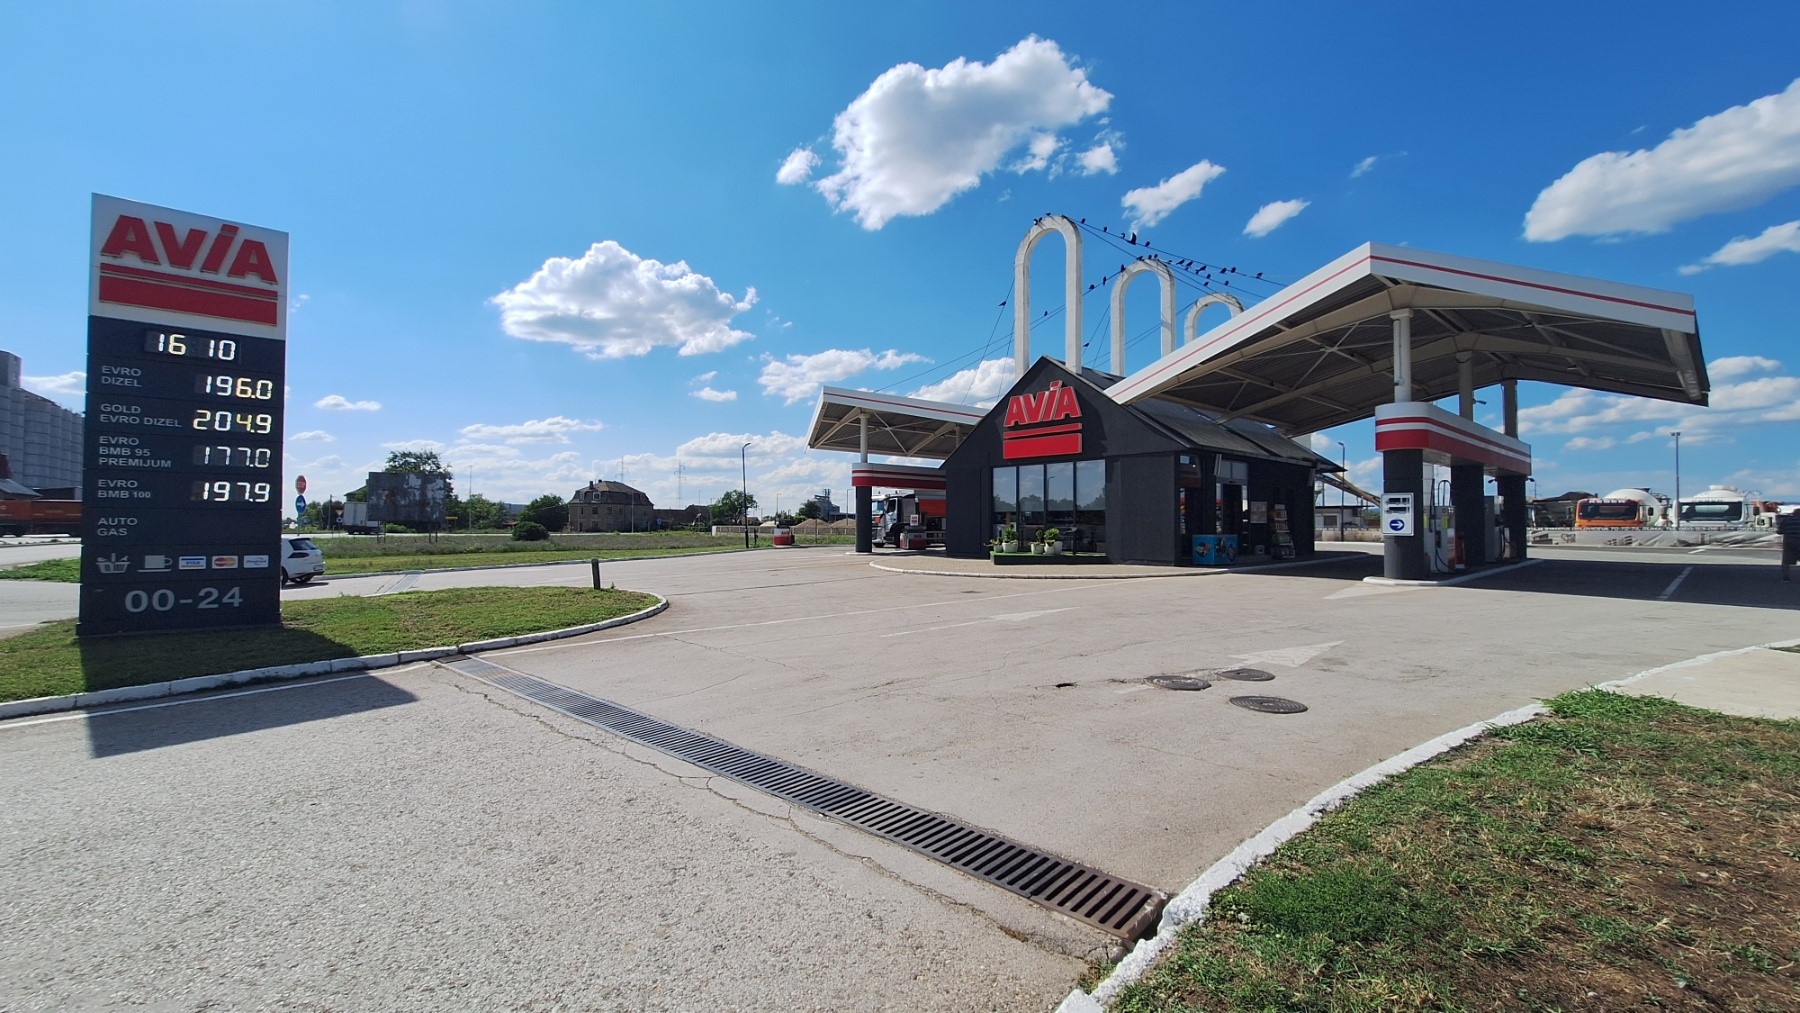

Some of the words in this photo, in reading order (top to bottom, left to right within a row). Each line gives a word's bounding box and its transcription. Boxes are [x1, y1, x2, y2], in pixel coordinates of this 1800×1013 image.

[157, 333, 186, 356] 16
[208, 339, 236, 361] 10
[101, 365, 142, 377] EVRO
[101, 376, 142, 388] DIZEL
[205, 375, 273, 400] 196.0
[100, 403, 141, 414] GOLD
[100, 414, 141, 425] EVRO
[144, 416, 182, 427] DIZEL
[192, 409, 272, 434] 204.9
[99, 435, 140, 446] EVRO
[99, 446, 131, 456] BMB
[135, 448, 150, 457] 95
[203, 446, 271, 468] 177.0
[99, 457, 172, 469] PREMIJUM
[98, 479, 138, 488] EVRO
[98, 490, 130, 498] BMB
[132, 490, 151, 499] 100
[202, 481, 271, 503] 197.9
[98, 517, 138, 526] AUTO
[97, 527, 128, 537] GAS
[125, 586, 243, 613] 00-24
